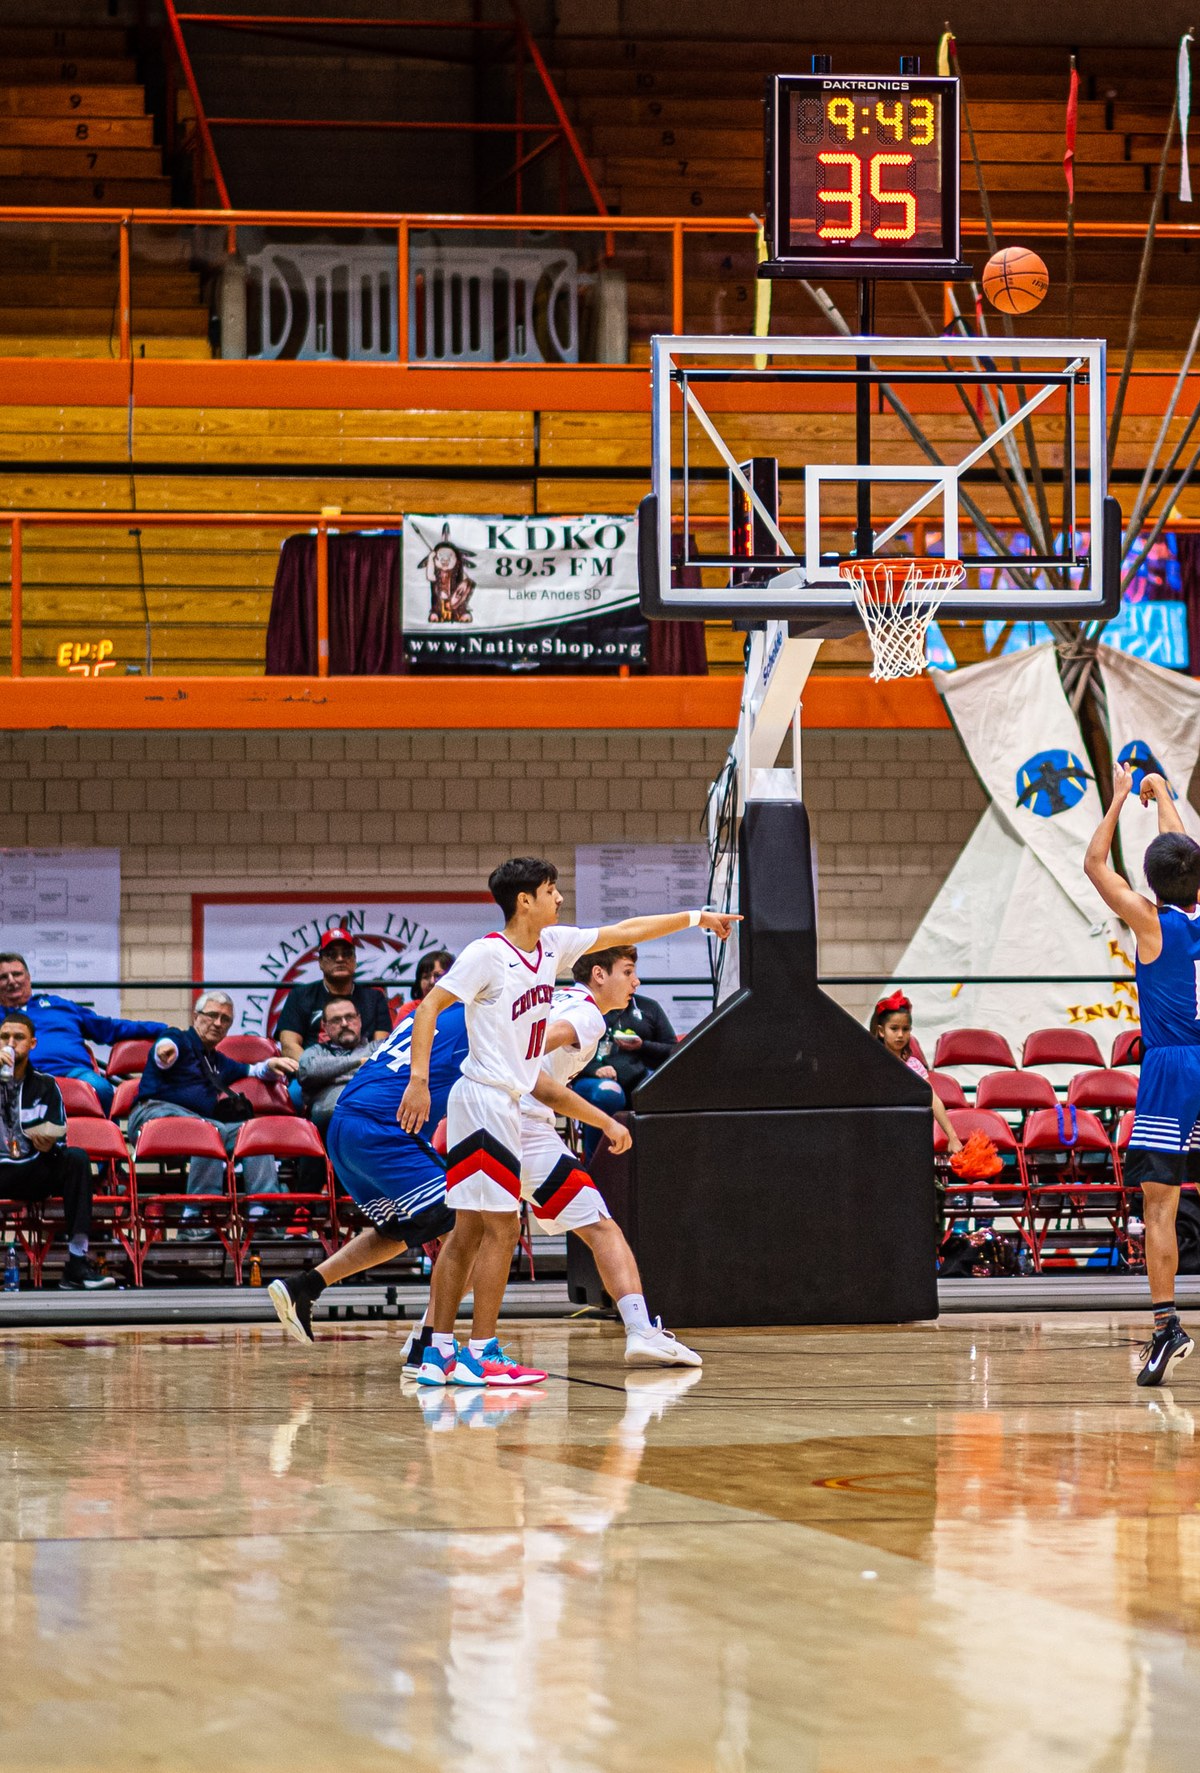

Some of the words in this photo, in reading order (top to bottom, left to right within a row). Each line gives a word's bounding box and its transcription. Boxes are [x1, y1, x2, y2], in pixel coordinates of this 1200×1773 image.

[823, 81, 910, 91] DAKTRONICS
[70, 95, 81, 109] 9
[828, 97, 935, 146] 9:43
[76, 124, 88, 140] 8
[663, 131, 675, 146] 8
[87, 153, 97, 170] 7
[679, 161, 689, 177] 7
[691, 192, 702, 206] 6
[817, 153, 917, 240] 35
[485, 524, 626, 551] KDKO
[495, 557, 556, 577] 89.5
[569, 557, 615, 577] FM
[508, 588, 537, 600] Lake
[542, 588, 580, 600] Andes
[584, 588, 602, 600] SD
[410, 638, 642, 658] www.NativeShop.org
